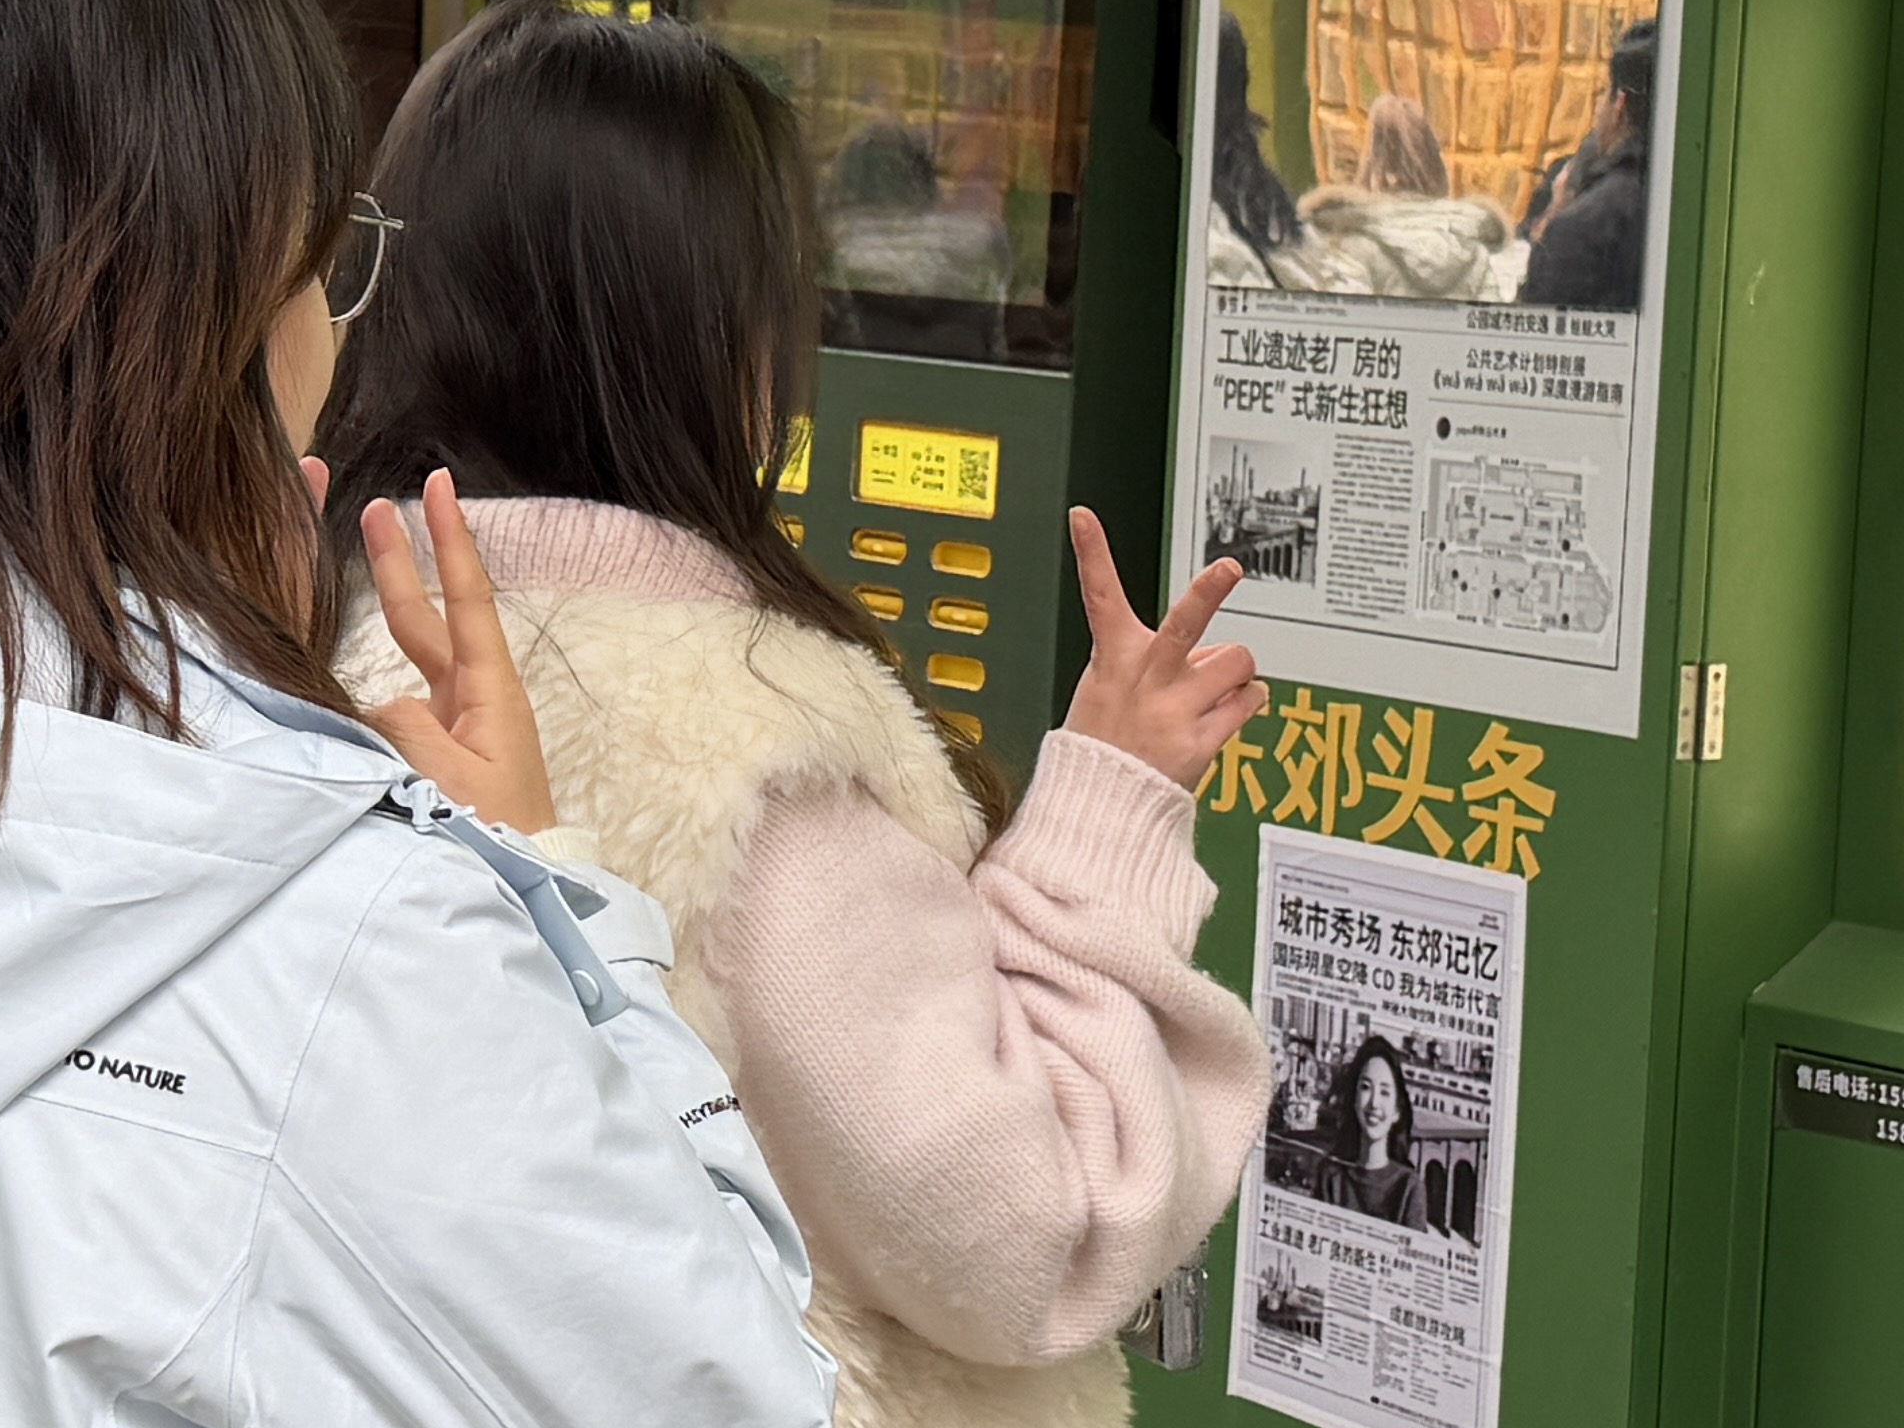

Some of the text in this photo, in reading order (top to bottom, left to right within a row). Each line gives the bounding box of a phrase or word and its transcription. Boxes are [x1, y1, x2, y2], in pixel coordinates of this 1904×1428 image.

[1217, 328, 1402, 380] 工业遗迹老厂房的
[1389, 919, 1499, 982] 东郊记忆
[1372, 967, 1395, 992] CD
[98, 1055, 187, 1095] NATURE
